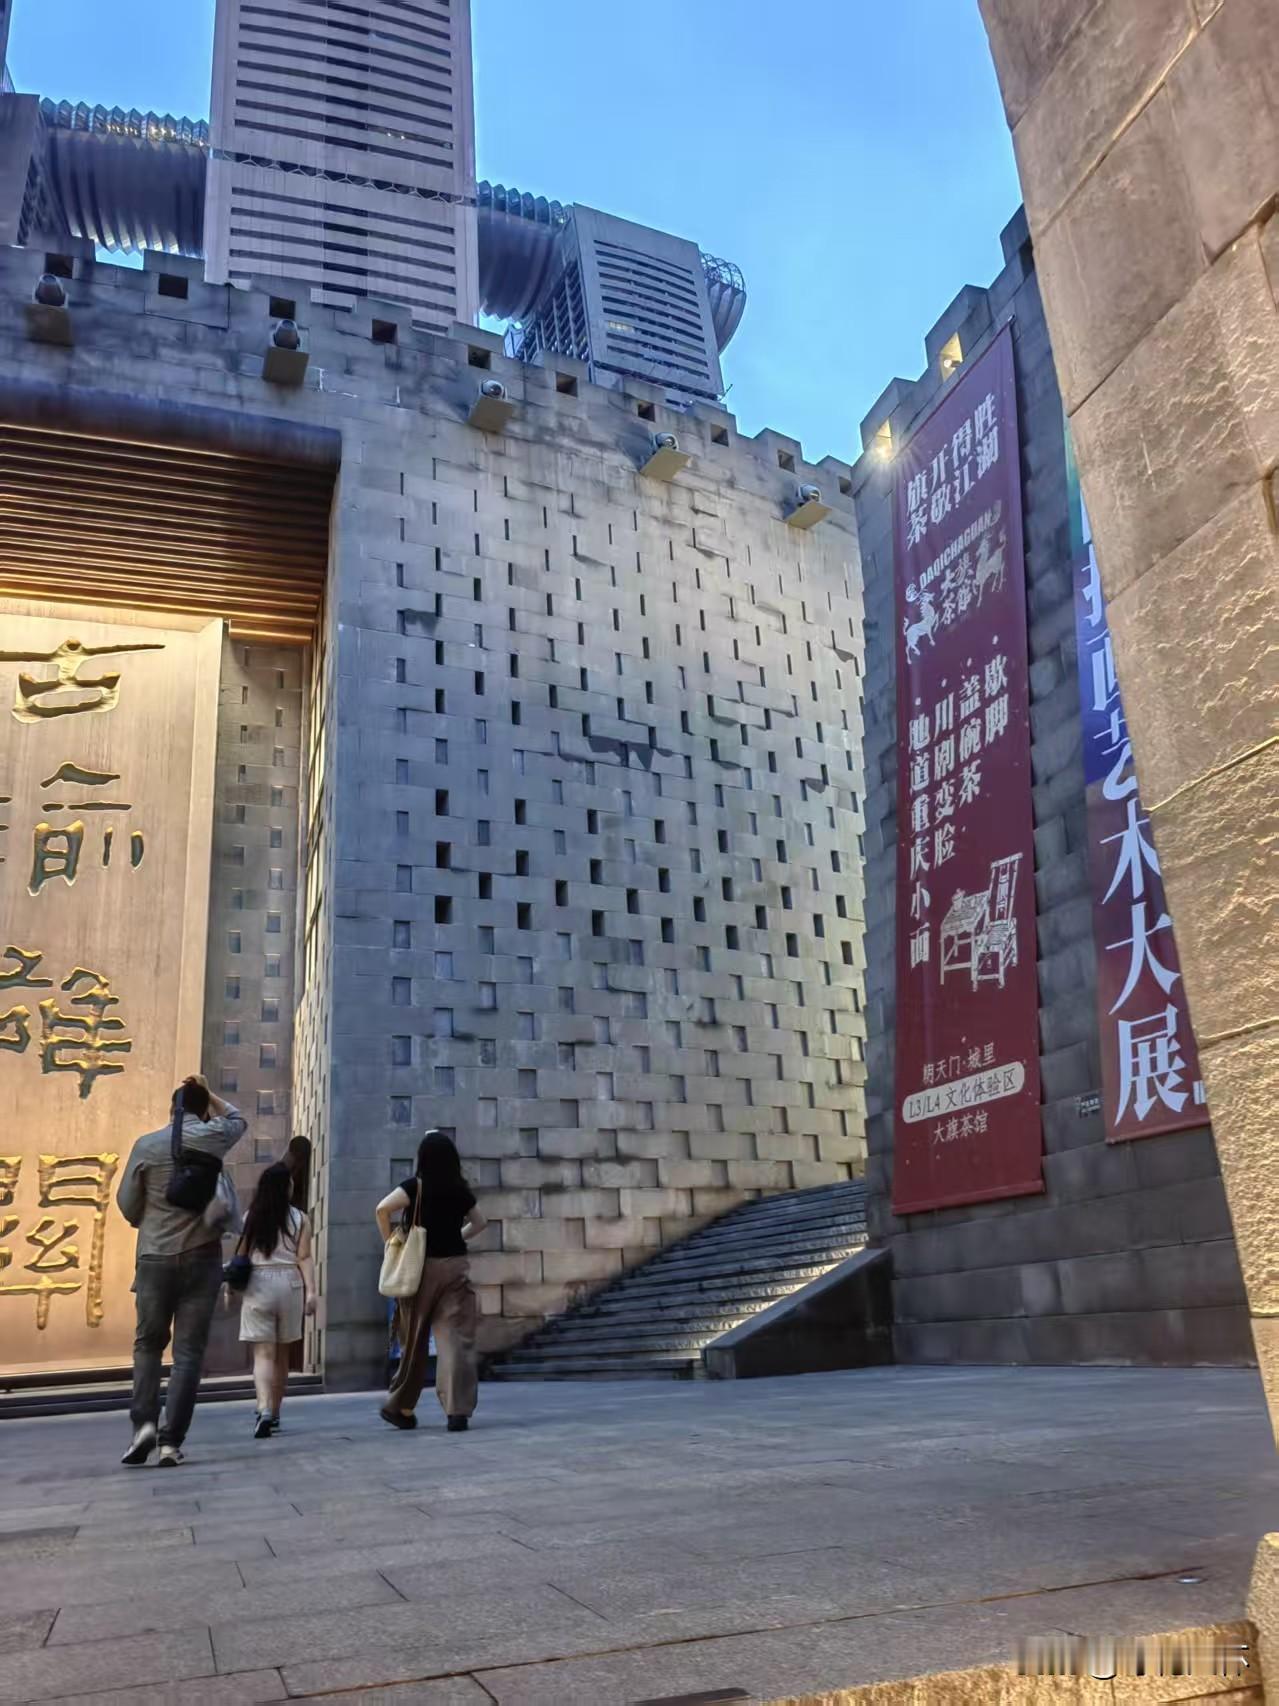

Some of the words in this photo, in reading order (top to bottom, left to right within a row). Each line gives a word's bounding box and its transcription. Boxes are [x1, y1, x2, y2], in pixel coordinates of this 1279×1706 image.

[907, 393, 997, 514] 旗开得胜
[907, 426, 999, 551] 茶敬江湖
[958, 673, 982, 808] 盖碗茶
[984, 654, 1009, 748] 歇脚
[908, 713, 931, 969] 地道重庆小面
[933, 692, 956, 870] 川剧变脸
[909, 1093, 941, 1119] L3/L4
[945, 1068, 1016, 1110] 文化体验区
[933, 1110, 989, 1145] 大旗茶馆
